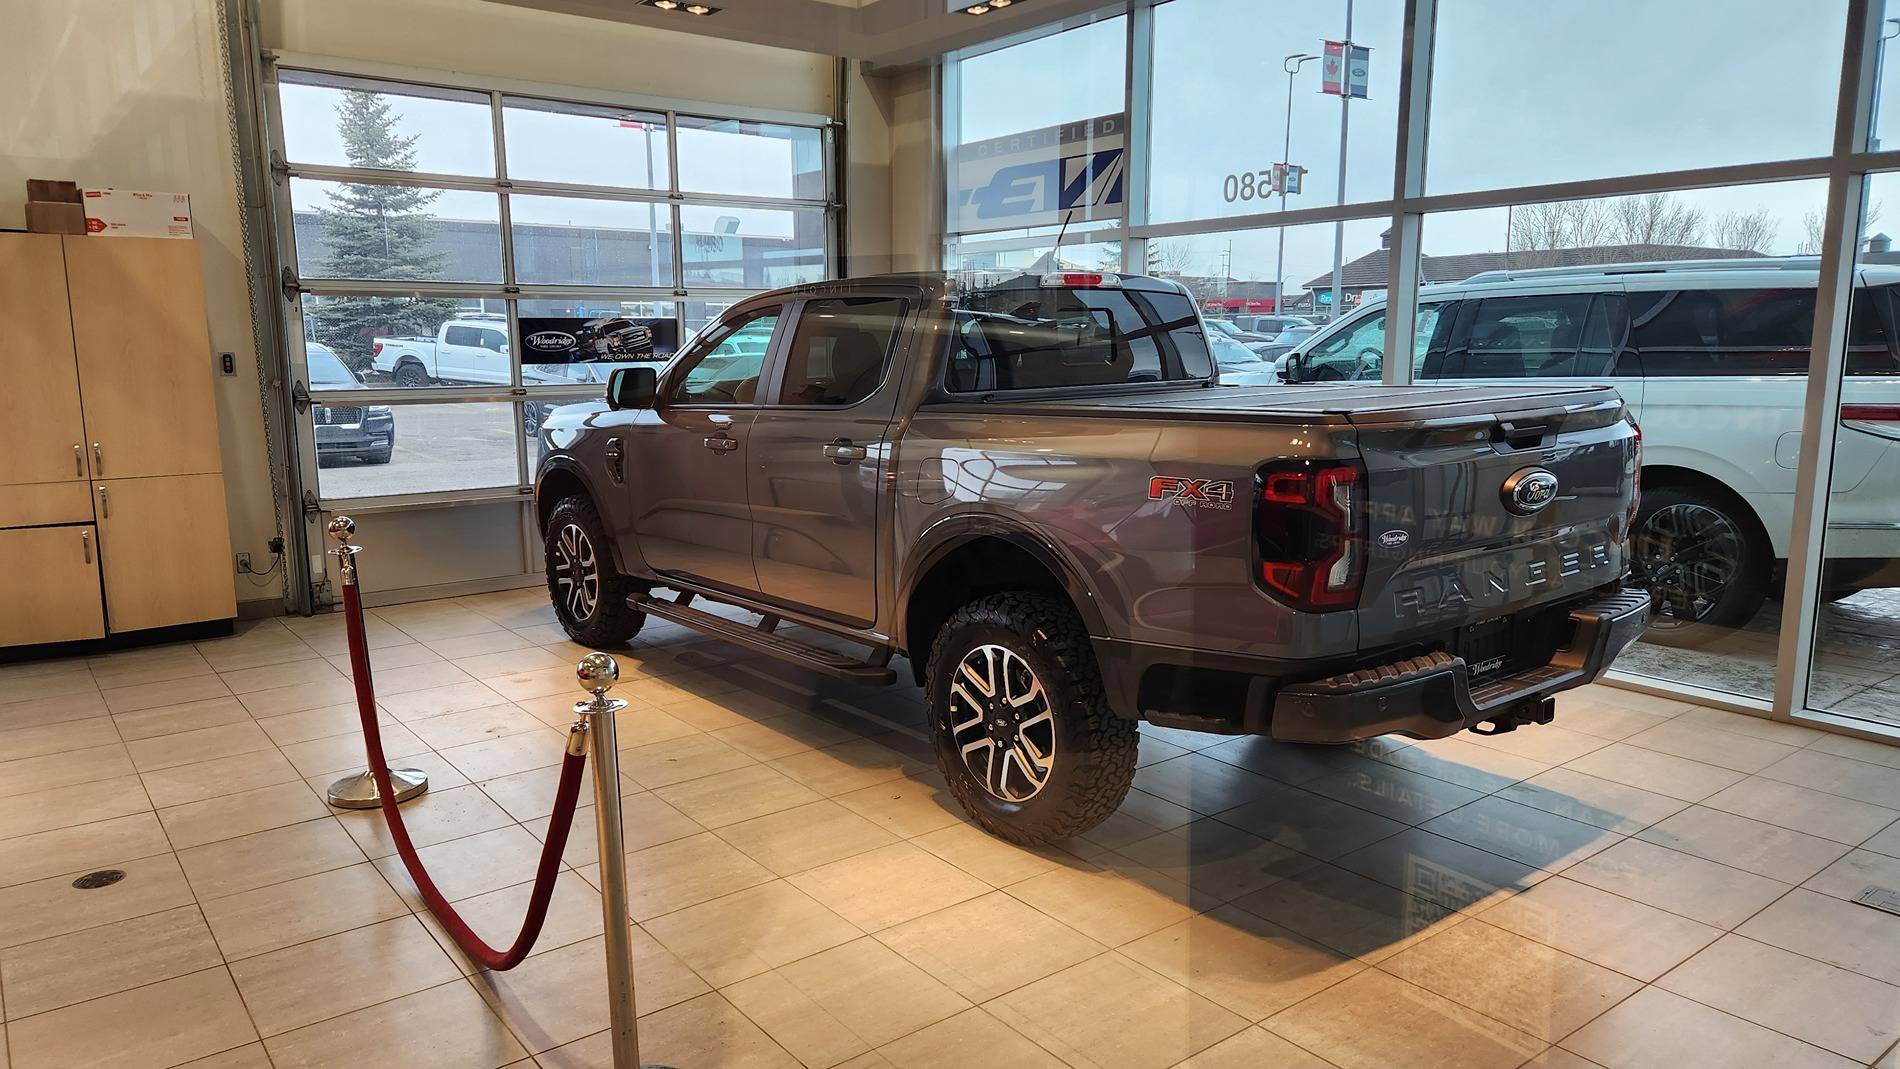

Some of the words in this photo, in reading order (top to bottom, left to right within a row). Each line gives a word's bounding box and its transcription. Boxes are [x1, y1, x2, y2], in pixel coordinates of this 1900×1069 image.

[636, 352, 654, 360] THE
[1148, 475, 1234, 503] FX4
[1526, 480, 1550, 502] Ford
[1173, 498, 1197, 507] OFF
[1200, 501, 1233, 511] ROAD
[1393, 545, 1610, 618] RANGER
[1472, 658, 1503, 676] Woodridge
